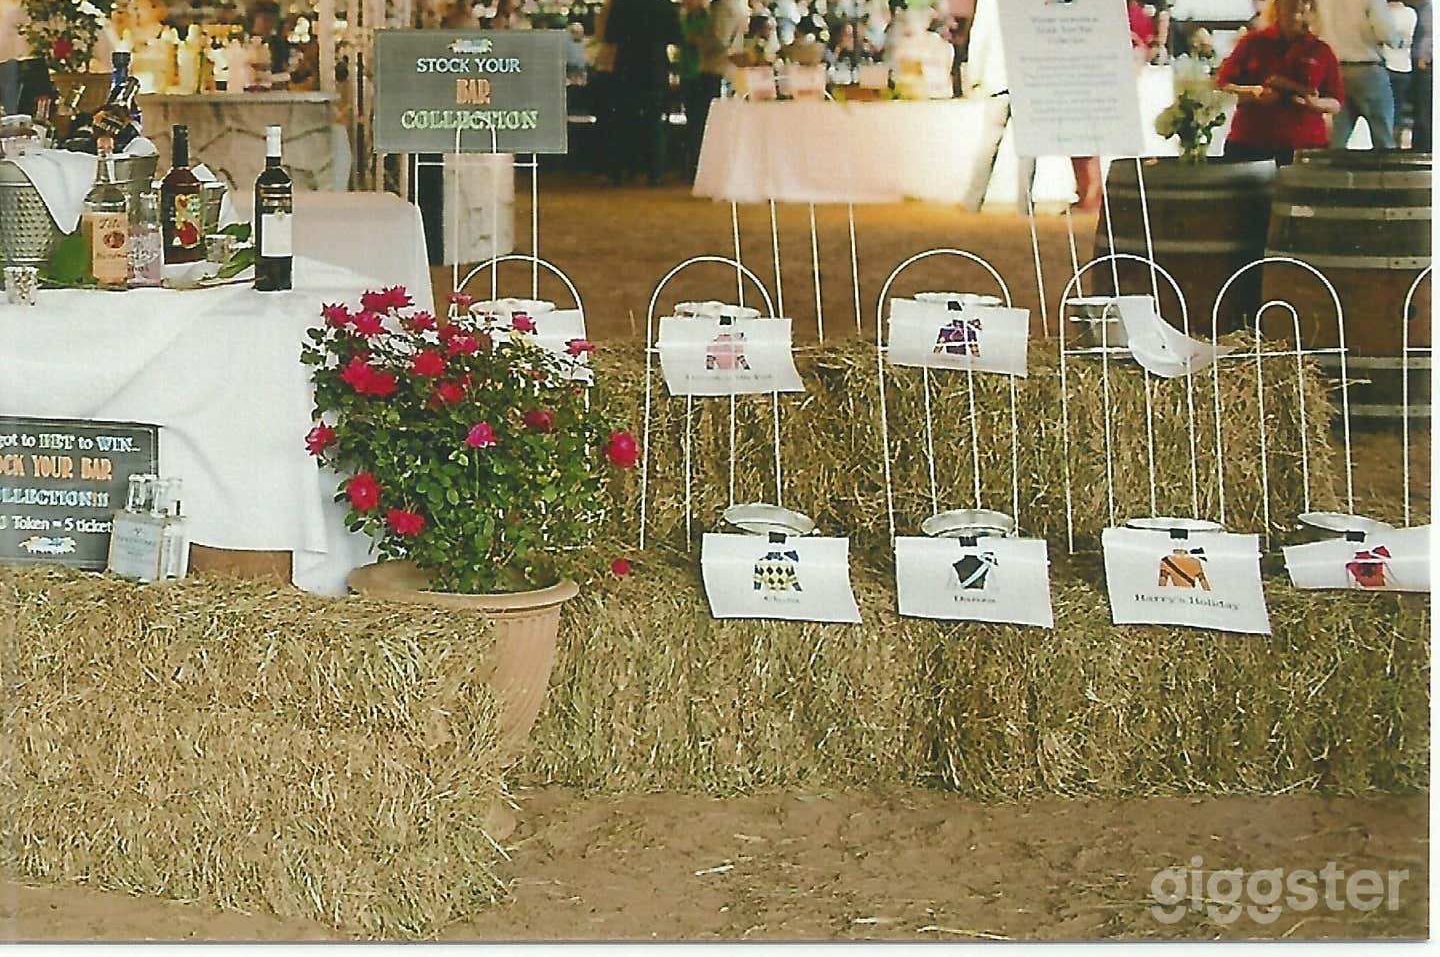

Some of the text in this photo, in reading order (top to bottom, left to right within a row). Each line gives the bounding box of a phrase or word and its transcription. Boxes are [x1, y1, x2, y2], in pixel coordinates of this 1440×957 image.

[416, 58, 521, 73] STOCK YOUR
[455, 78, 491, 105] BAR
[401, 109, 539, 130] COLLECTION
[21, 433, 37, 448] to
[38, 433, 76, 449] BET
[78, 435, 94, 450] to
[31, 455, 74, 479] YOUR
[80, 457, 113, 481] BAR
[11, 514, 51, 531] Token
[64, 517, 74, 532] 5
[76, 518, 113, 534] ticket
[1134, 593, 1240, 611] Harry's Holiday
